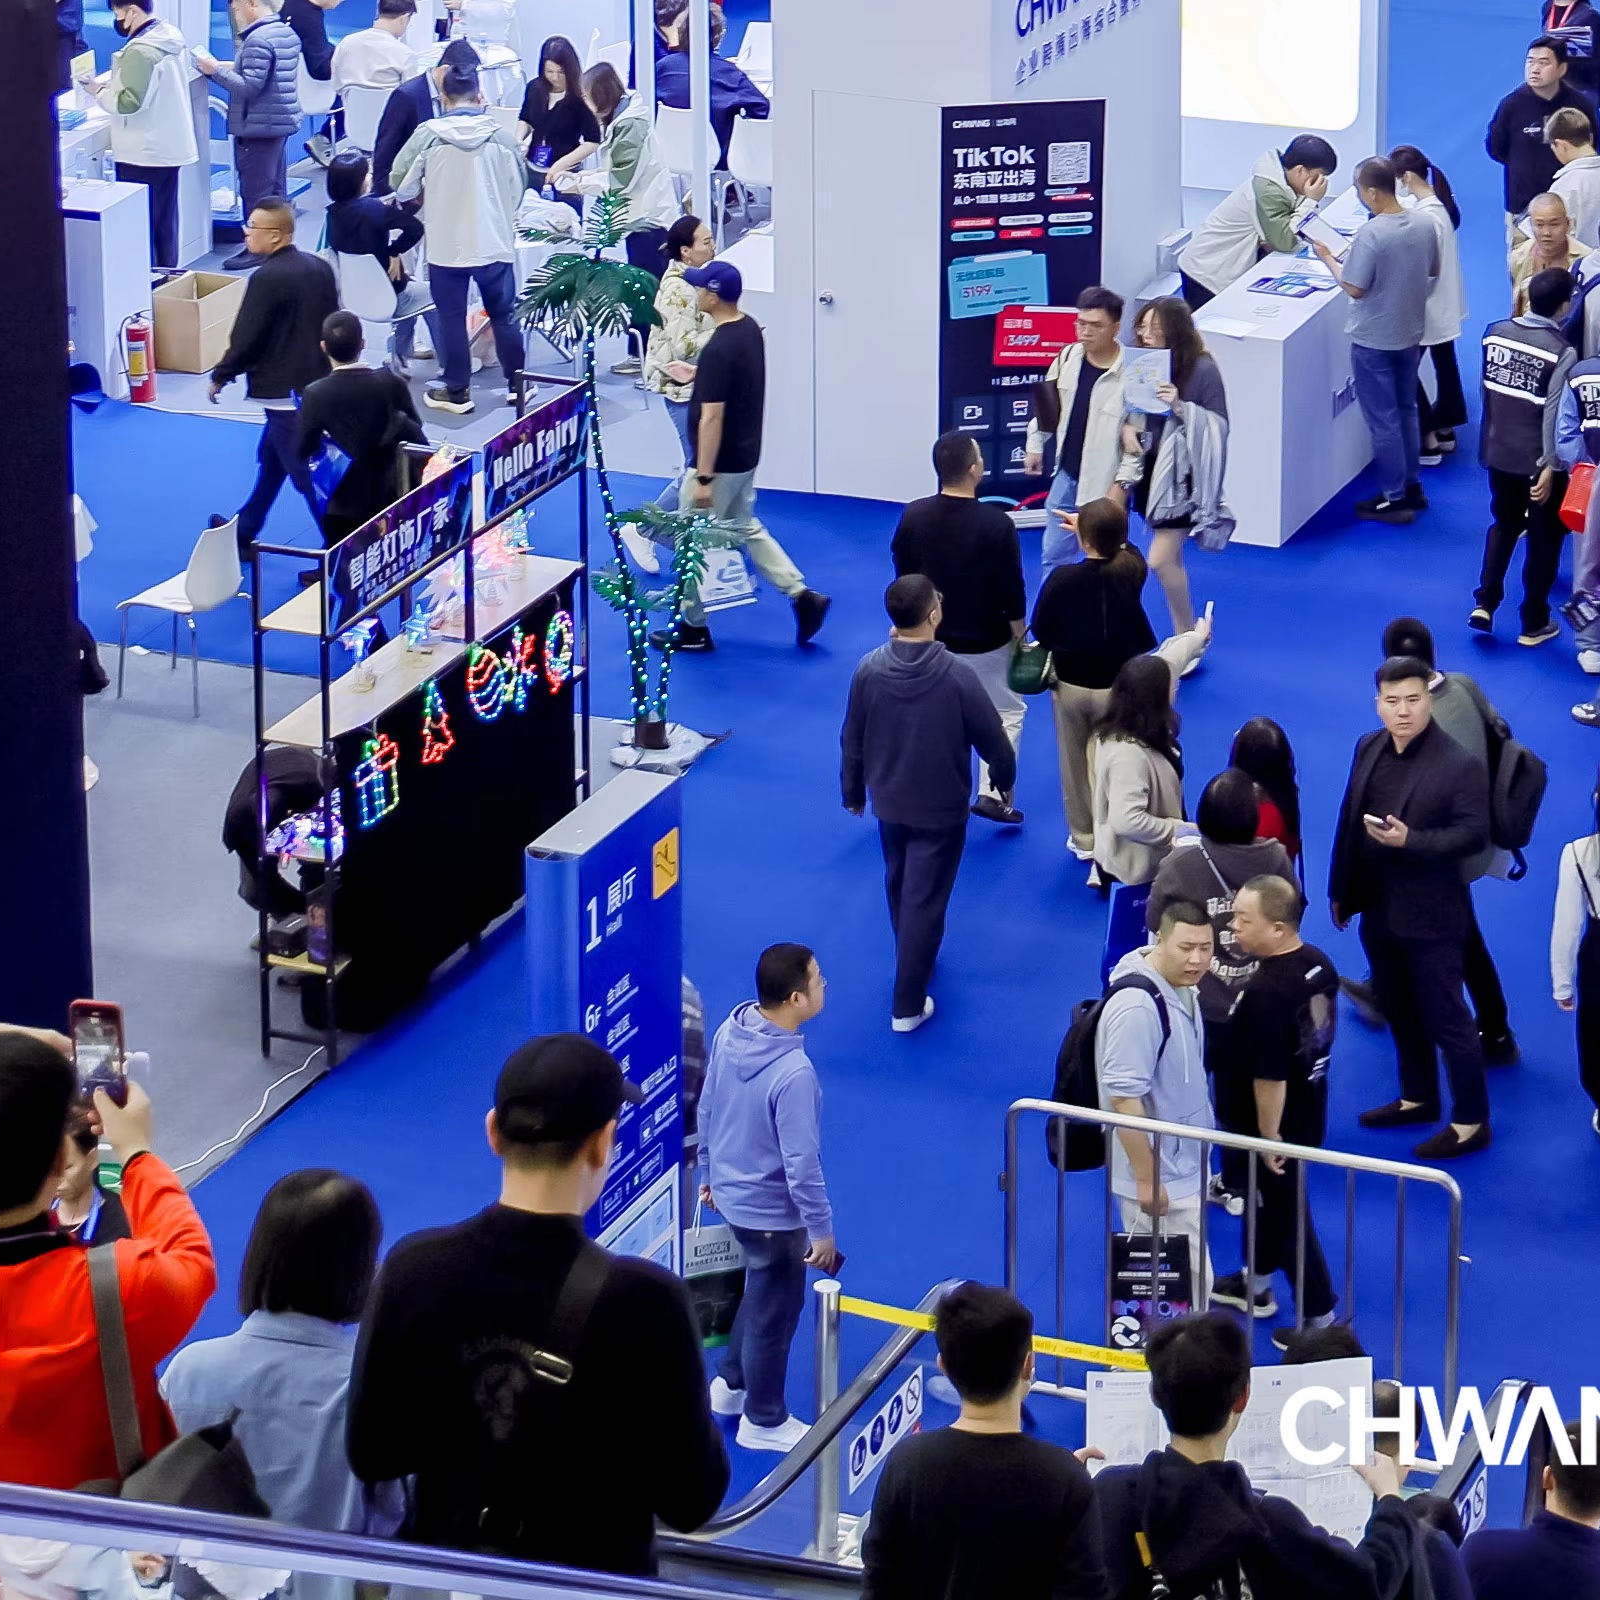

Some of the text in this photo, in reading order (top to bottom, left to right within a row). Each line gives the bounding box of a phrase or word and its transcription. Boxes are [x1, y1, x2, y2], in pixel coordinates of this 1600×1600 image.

[952, 145, 1036, 168] TikTok
[953, 169, 1037, 190] 东南亚出海
[493, 414, 579, 490] Hello Fairy
[349, 495, 451, 592] 智能灯饰厂家
[585, 865, 638, 954] 1 展厅
